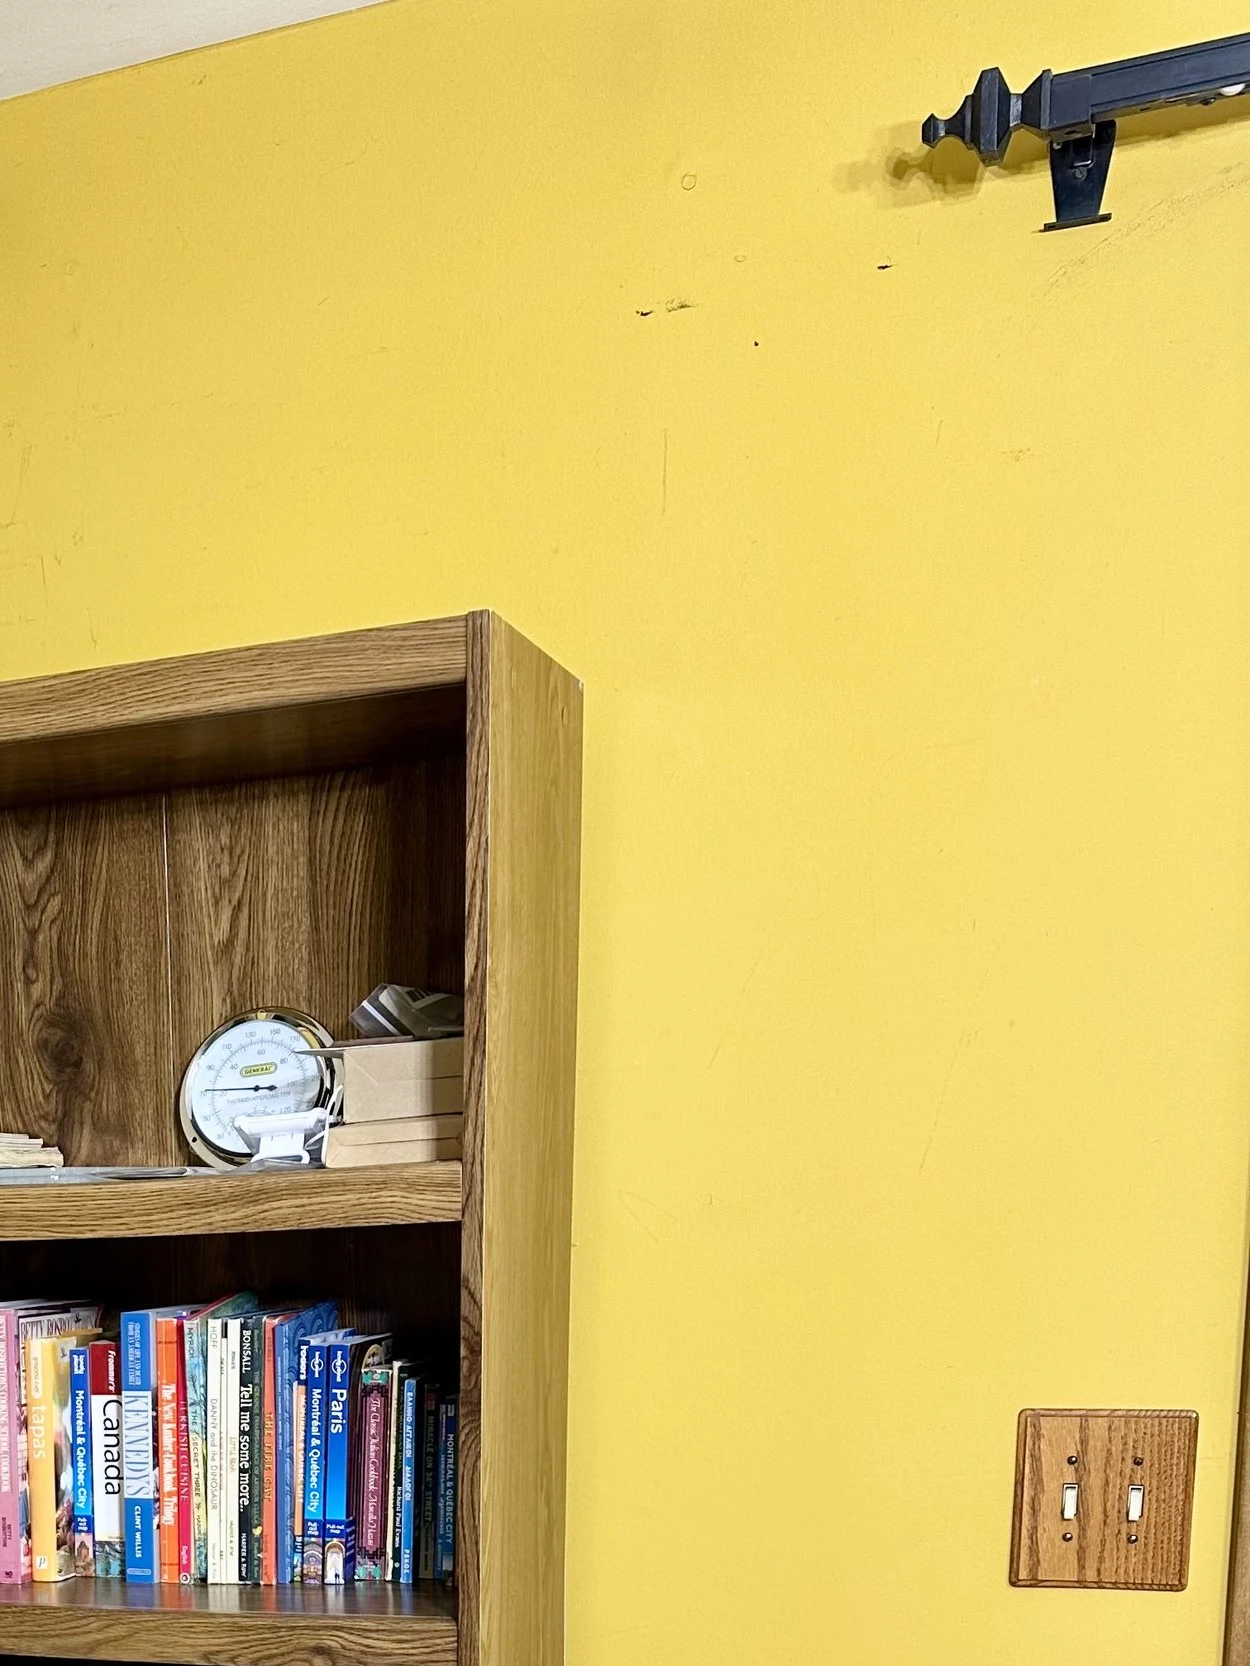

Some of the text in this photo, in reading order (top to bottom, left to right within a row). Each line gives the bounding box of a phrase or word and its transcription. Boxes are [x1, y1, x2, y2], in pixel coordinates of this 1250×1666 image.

[209, 1326, 218, 1349] HOFF
[242, 1330, 252, 1373] BONSALL
[108, 1350, 117, 1392] Frommer's
[240, 1384, 252, 1407] Tell
[30, 1405, 47, 1459] tapas
[240, 1412, 250, 1431] me
[331, 1388, 346, 1434] Paris
[75, 1390, 88, 1508] Montréal & Québec City
[102, 1399, 123, 1496] Canada
[124, 1394, 152, 1497] KENNEDYS
[191, 1409, 202, 1498] THE SECRET THREE
[210, 1398, 219, 1510] DANNY and the DINOSAUR
[238, 1434, 251, 1469] some
[308, 1388, 322, 1513] Montréal & Québec City
[134, 1505, 142, 1558] CLINT WILLIS
